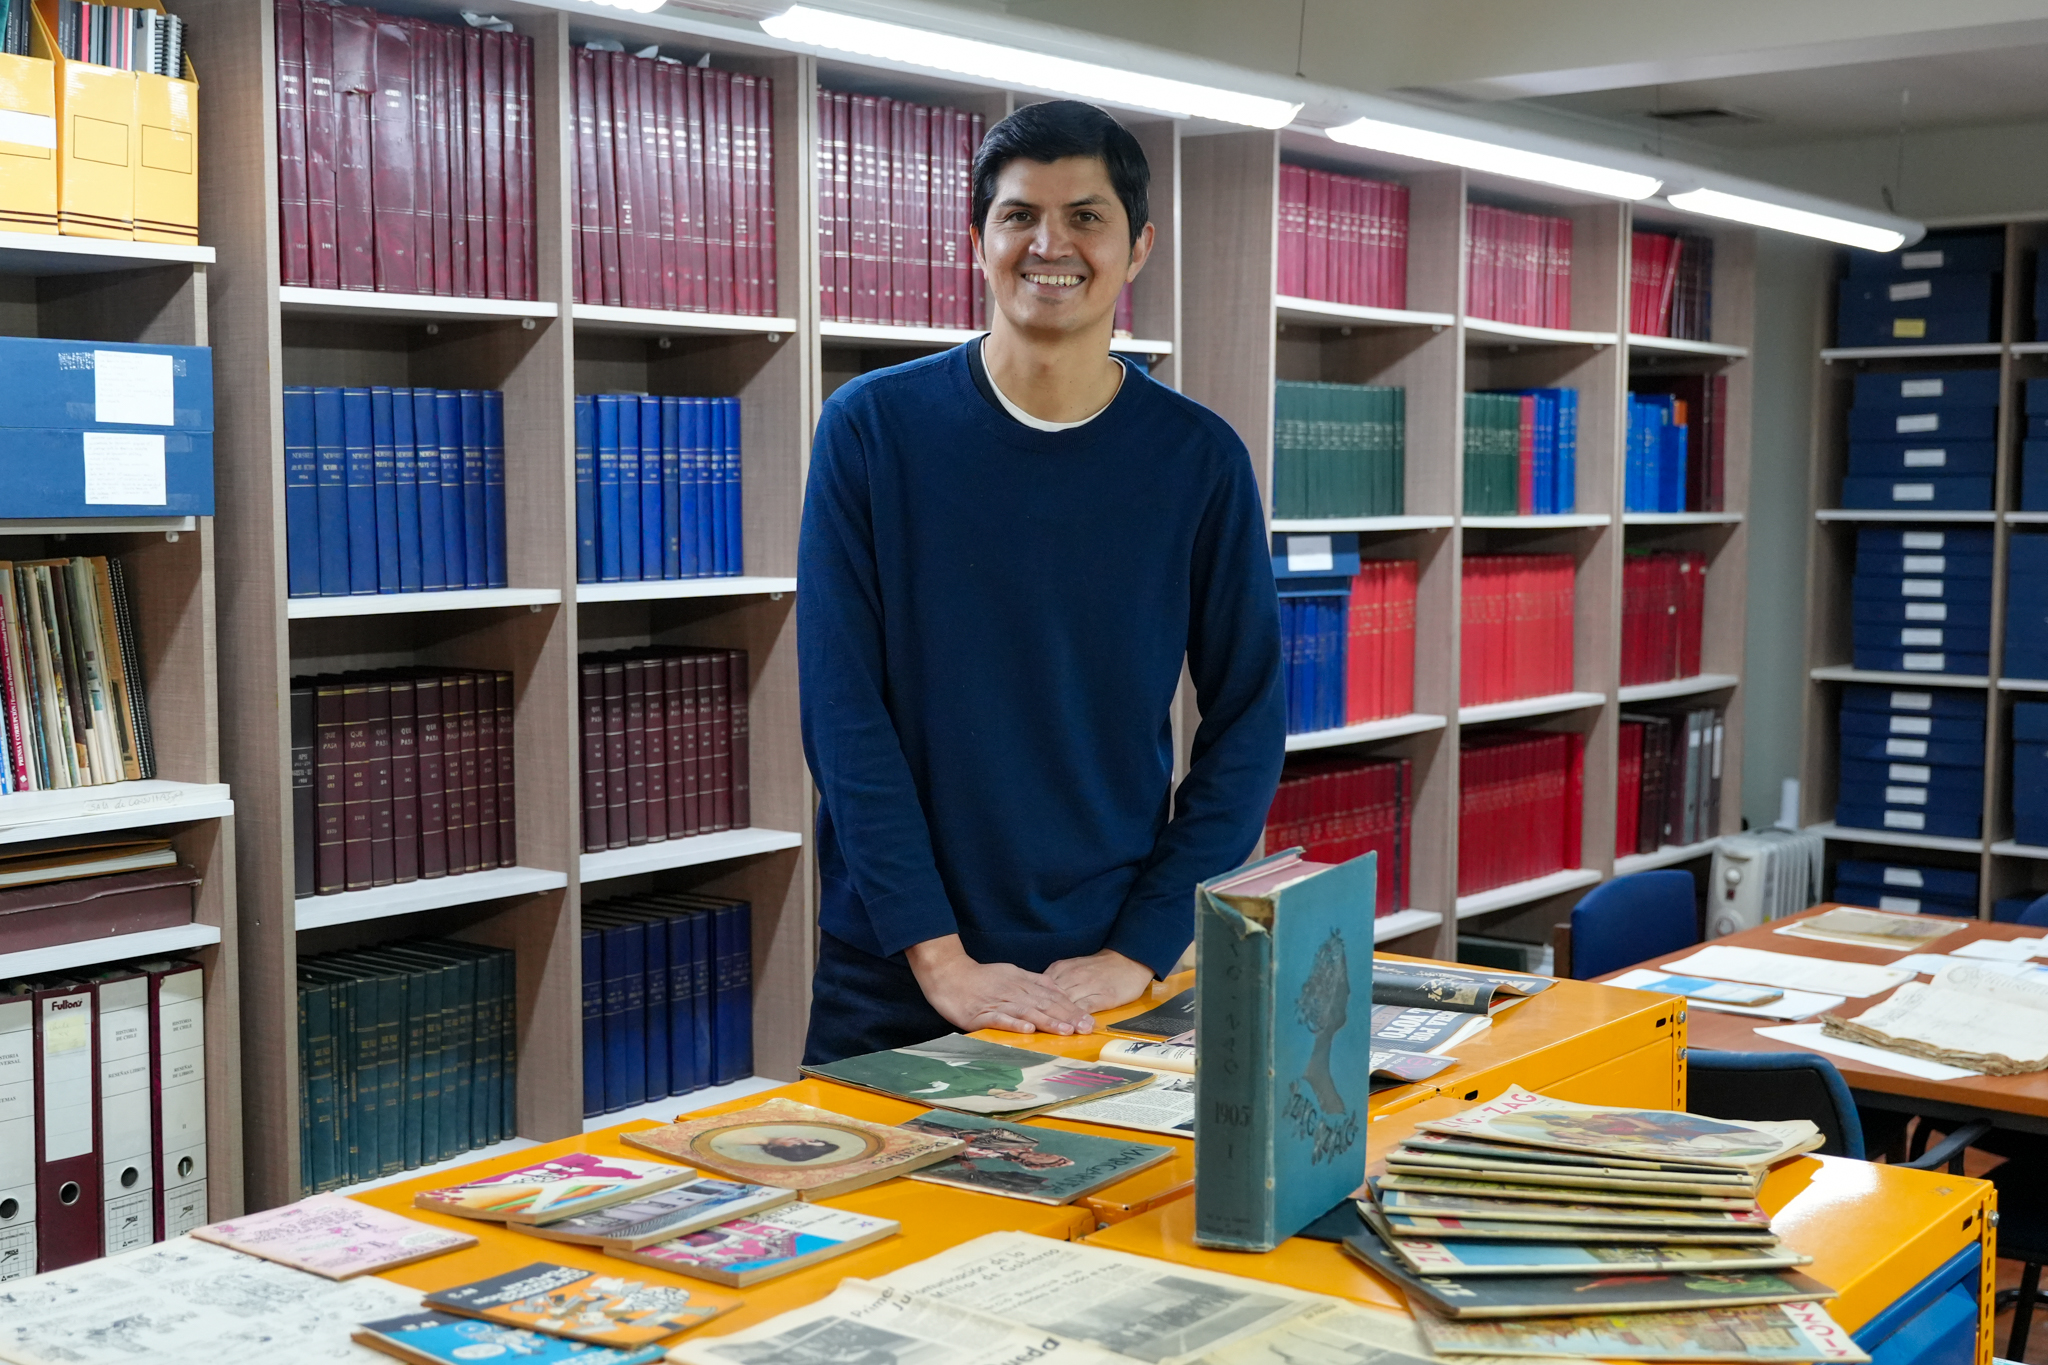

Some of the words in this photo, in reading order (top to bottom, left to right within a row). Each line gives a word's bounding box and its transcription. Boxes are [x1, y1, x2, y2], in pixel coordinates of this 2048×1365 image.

[51, 998, 83, 1012] Fulton's
[1377, 1014, 1430, 1039] VOTO
[0, 1053, 19, 1061] STORIA
[990, 1257, 1009, 1266] de
[1006, 1250, 1025, 1258] la
[930, 1280, 978, 1298] Militar
[980, 1272, 1001, 1281] de
[999, 1248, 1060, 1272] Gobierno
